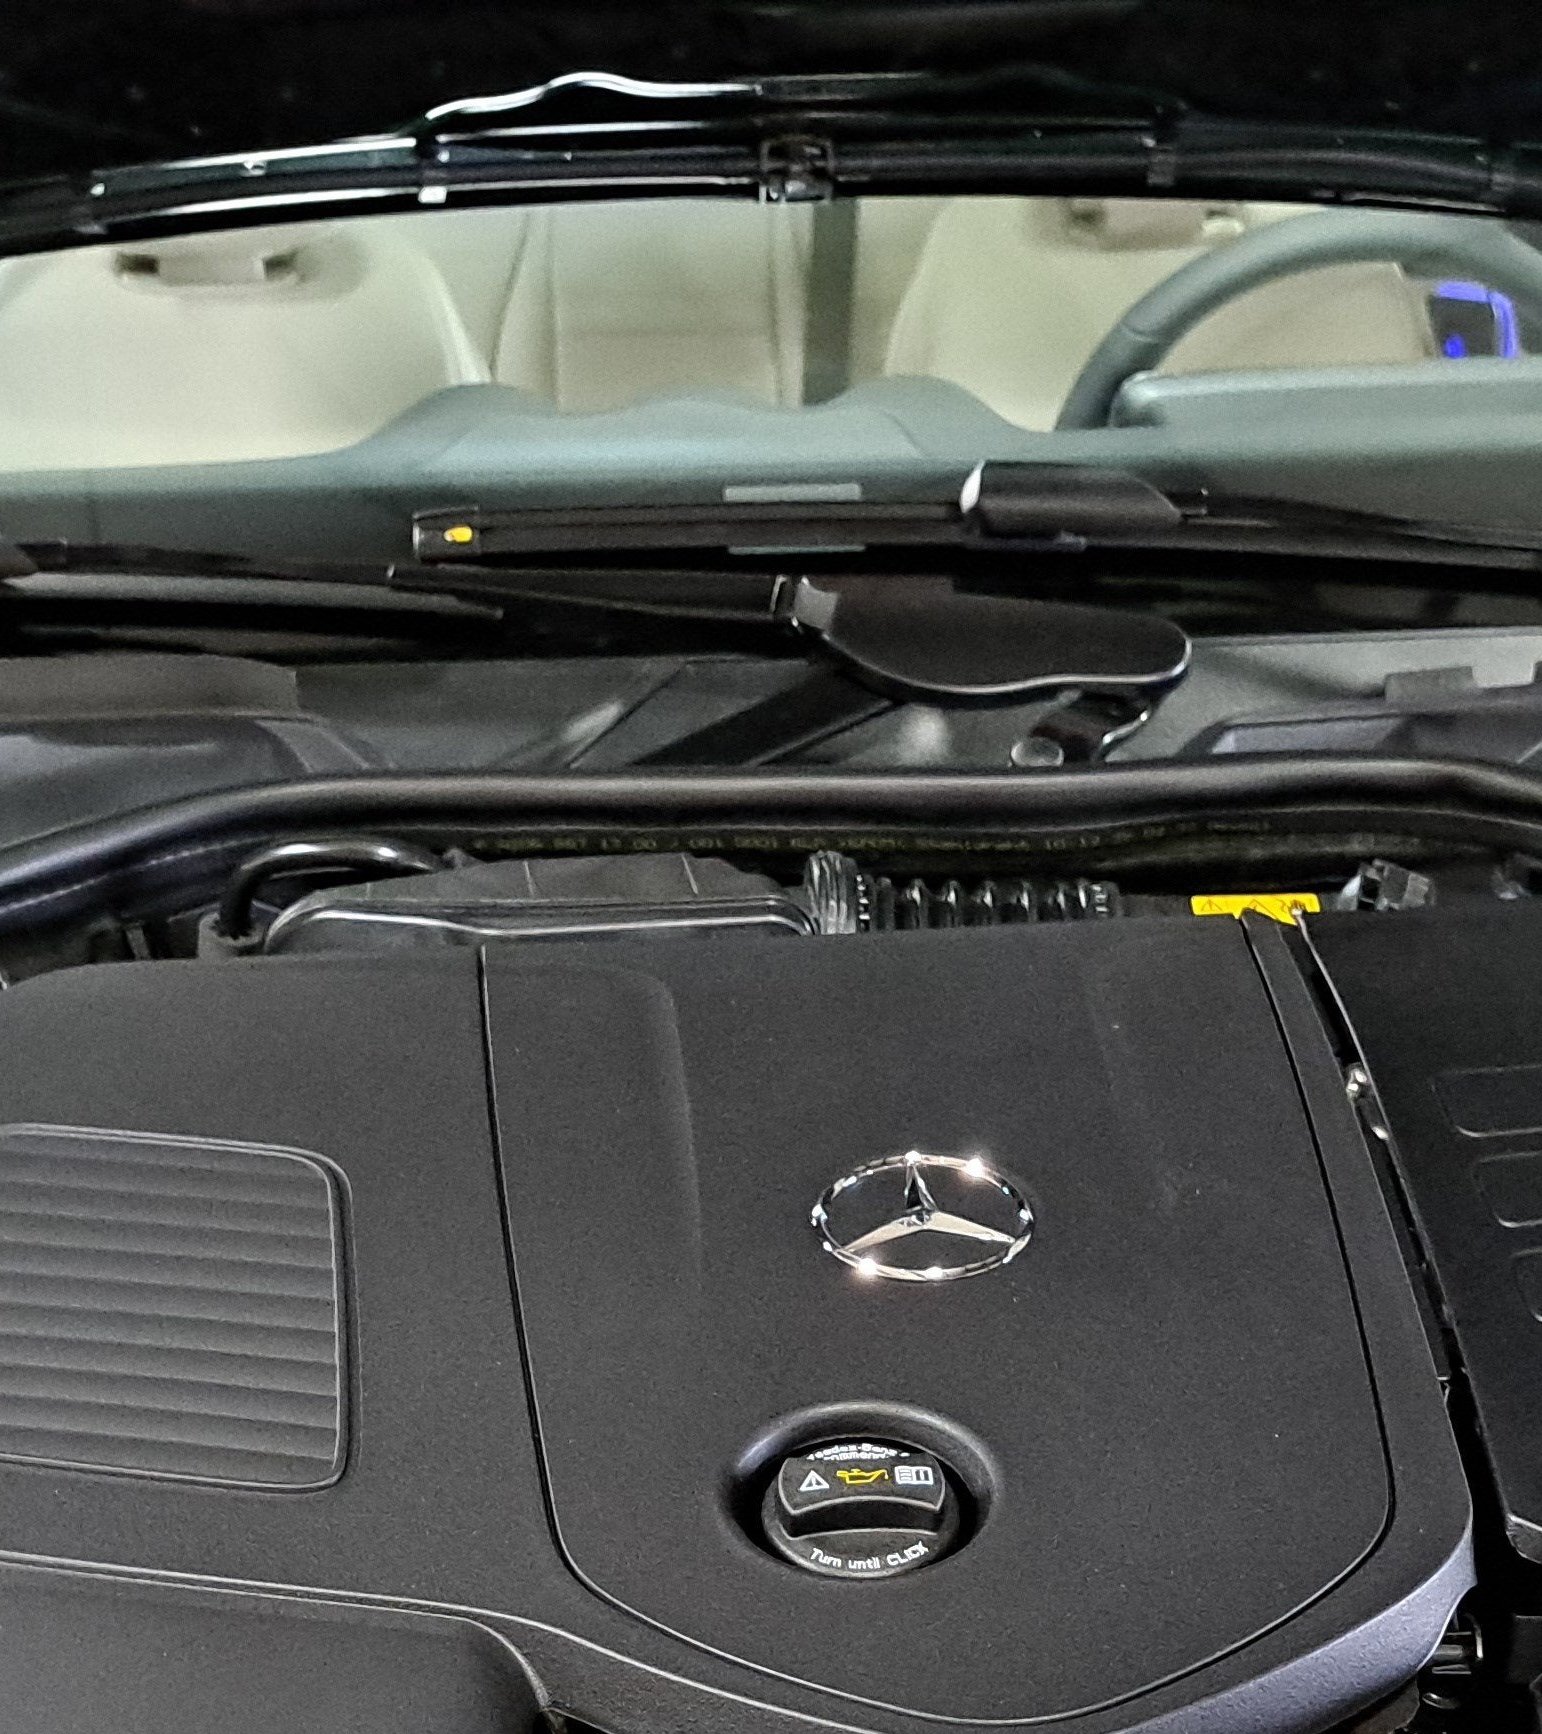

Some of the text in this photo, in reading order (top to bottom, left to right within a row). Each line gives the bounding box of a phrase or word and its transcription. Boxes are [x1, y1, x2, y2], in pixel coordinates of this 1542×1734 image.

[810, 1540, 929, 1570] Turn until CLICK
